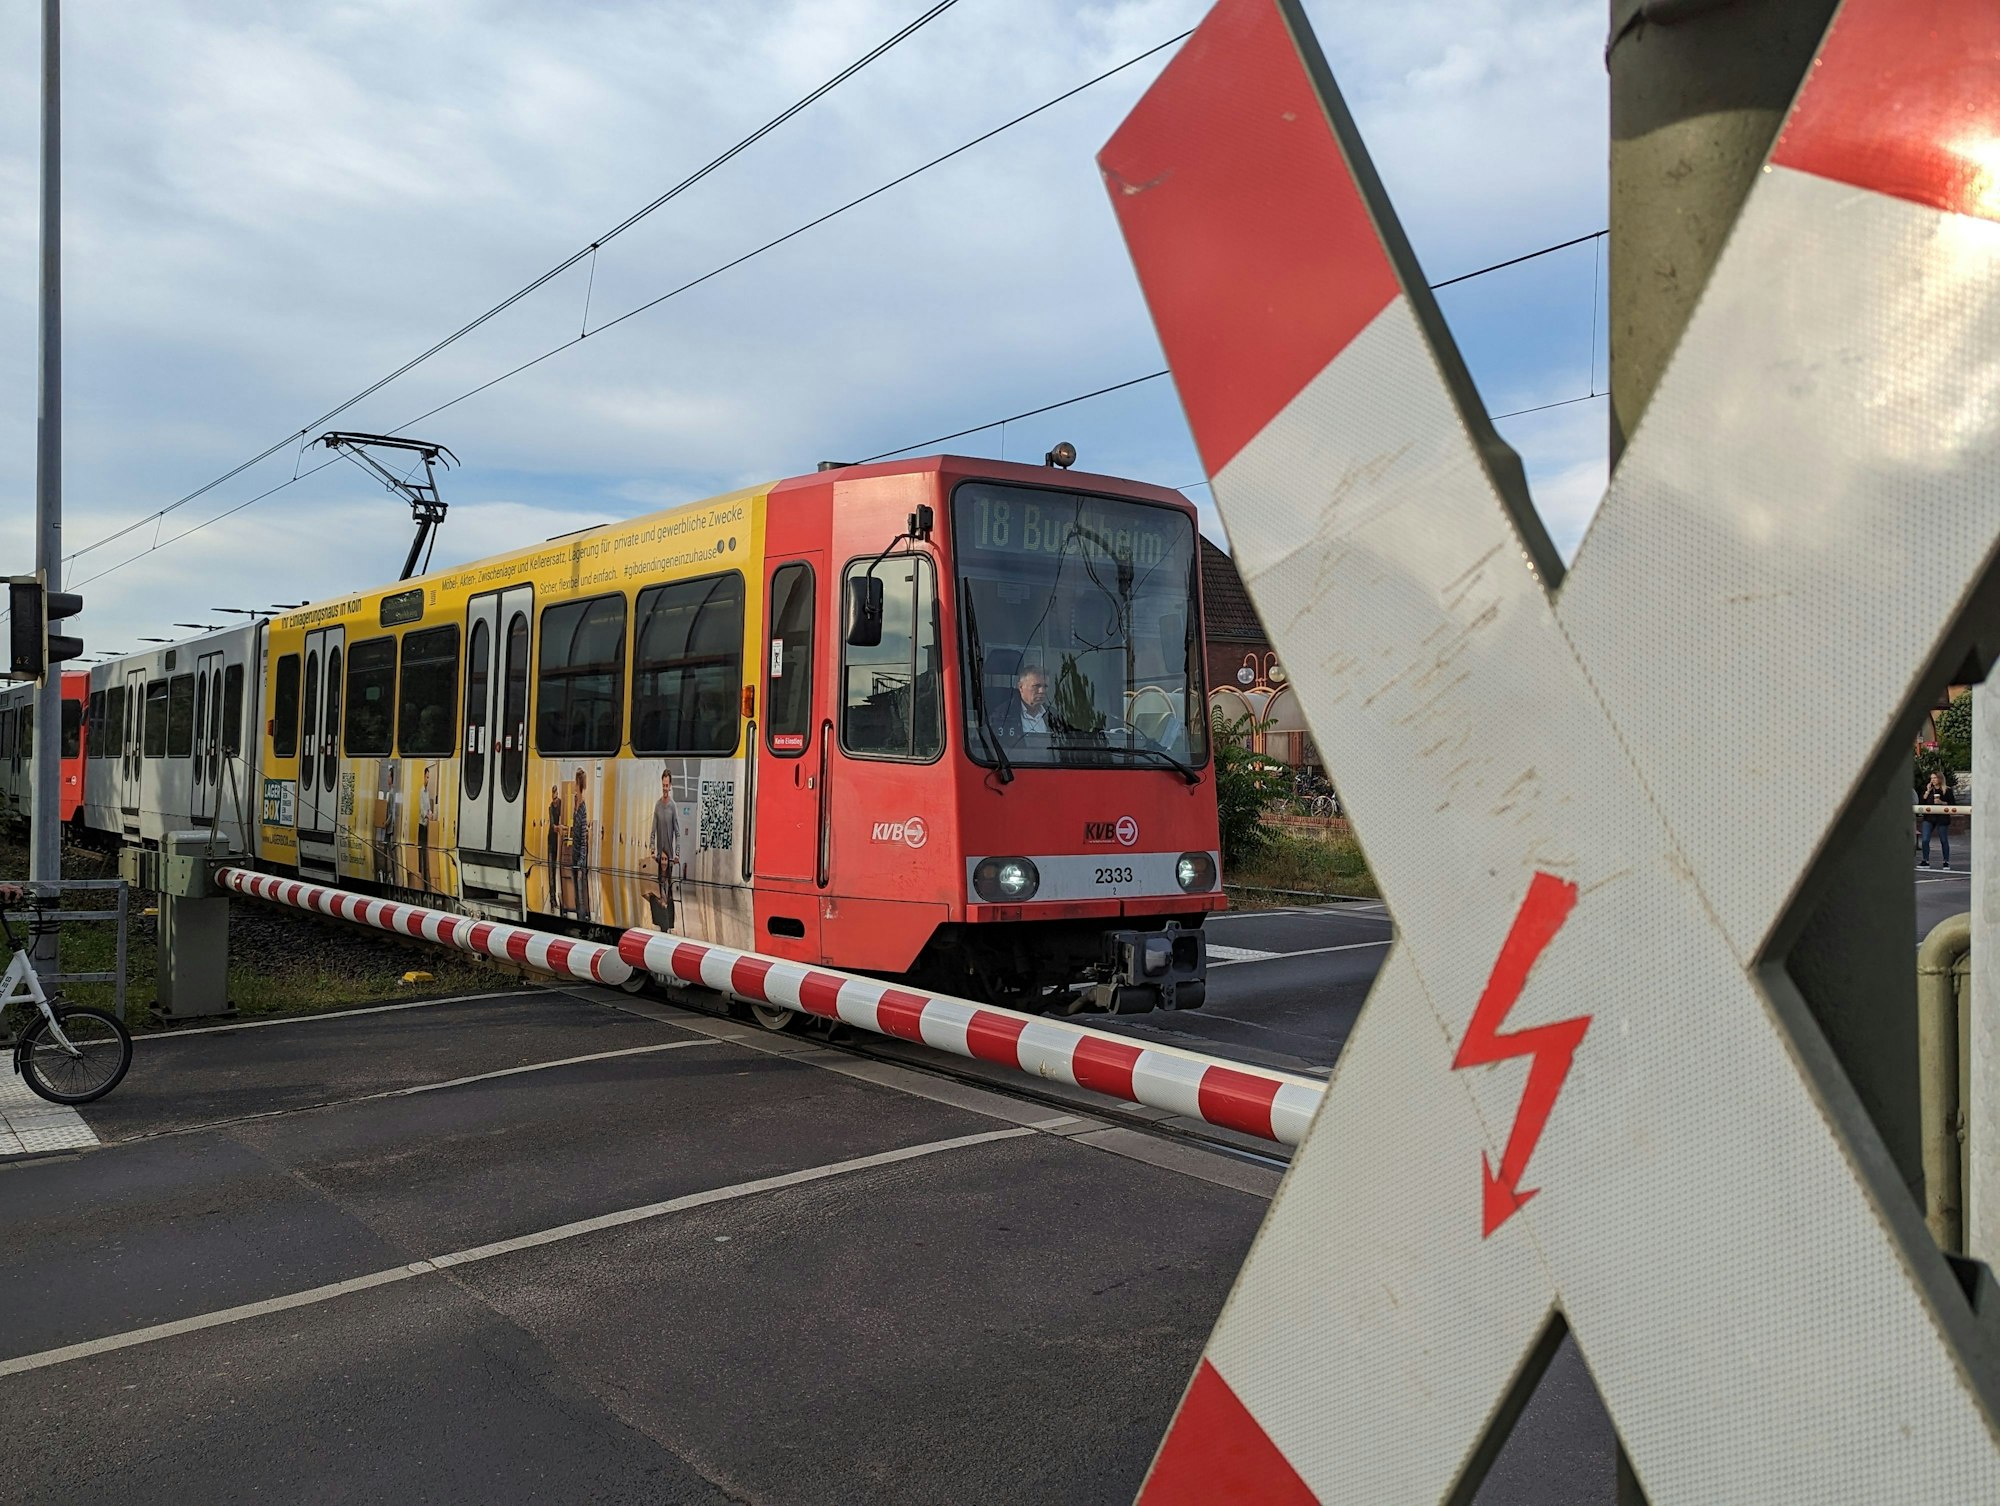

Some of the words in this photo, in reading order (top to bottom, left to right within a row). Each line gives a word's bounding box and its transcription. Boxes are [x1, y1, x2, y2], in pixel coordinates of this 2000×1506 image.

[518, 560, 529, 573] und
[530, 551, 567, 571] Kellerersatz,
[568, 543, 599, 564] Lagerung
[600, 535, 611, 553] für
[613, 531, 640, 554] private
[641, 526, 656, 543] und
[657, 513, 707, 544] gewerbliche
[708, 504, 745, 528] Zwecke.
[975, 498, 1009, 546] 18
[1023, 504, 1162, 563] Buchheim
[580, 573, 592, 586] und
[592, 567, 618, 583] einfach.
[774, 736, 785, 745] Kein
[785, 736, 803, 747] Einstieg
[264, 783, 281, 799] LAGER
[263, 800, 281, 821] BOX
[872, 823, 904, 841] KVB
[1085, 823, 1116, 840] KVB
[1095, 867, 1133, 884] 2333
